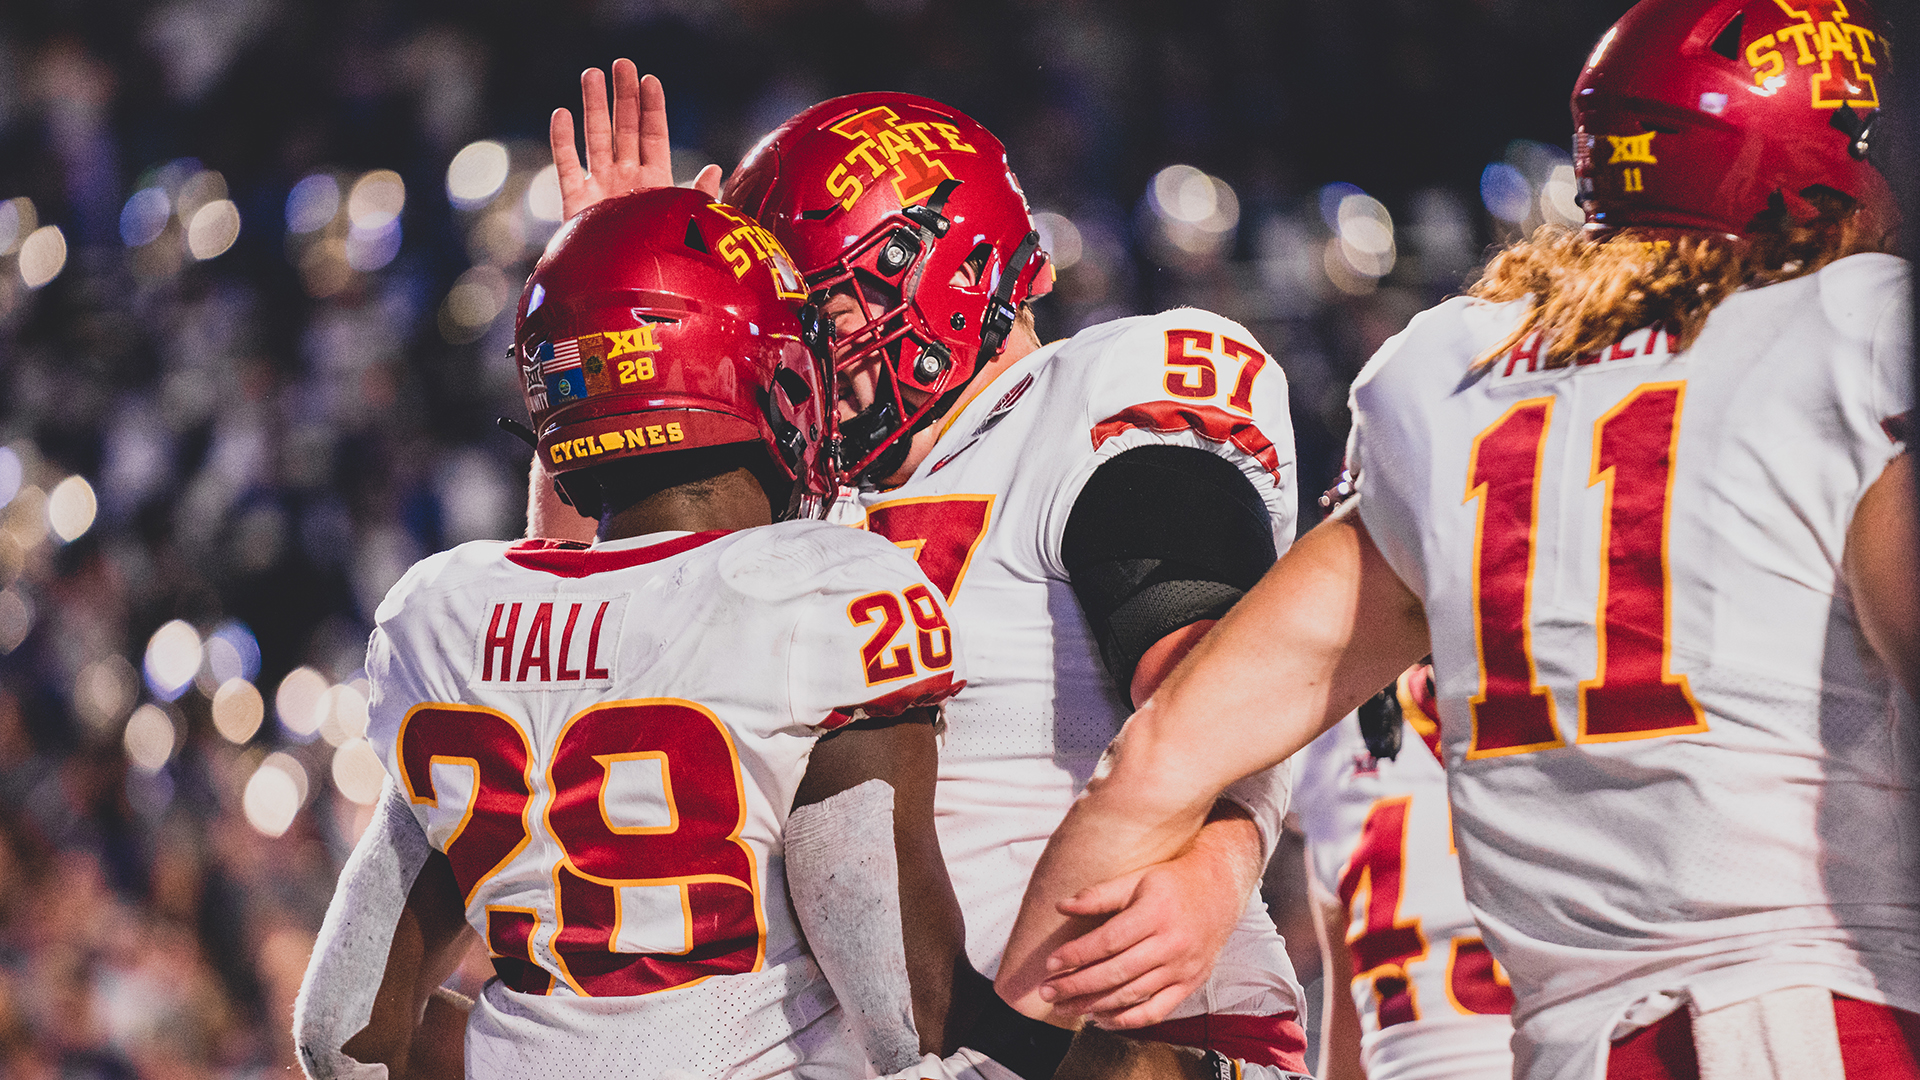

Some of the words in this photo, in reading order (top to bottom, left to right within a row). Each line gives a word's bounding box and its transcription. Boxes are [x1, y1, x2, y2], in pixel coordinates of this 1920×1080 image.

[1745, 21, 1893, 87] STAT
[825, 122, 977, 212] STATE
[1607, 131, 1658, 165] XII
[1623, 167, 1644, 192] 11
[718, 226, 789, 279] STA
[603, 323, 663, 360] XII
[617, 357, 655, 385] 28
[1163, 329, 1266, 416] 57
[848, 493, 997, 608] 7
[1462, 380, 1710, 760] 11
[481, 601, 611, 682] HALL
[845, 583, 952, 688] 28
[396, 697, 768, 998] 28
